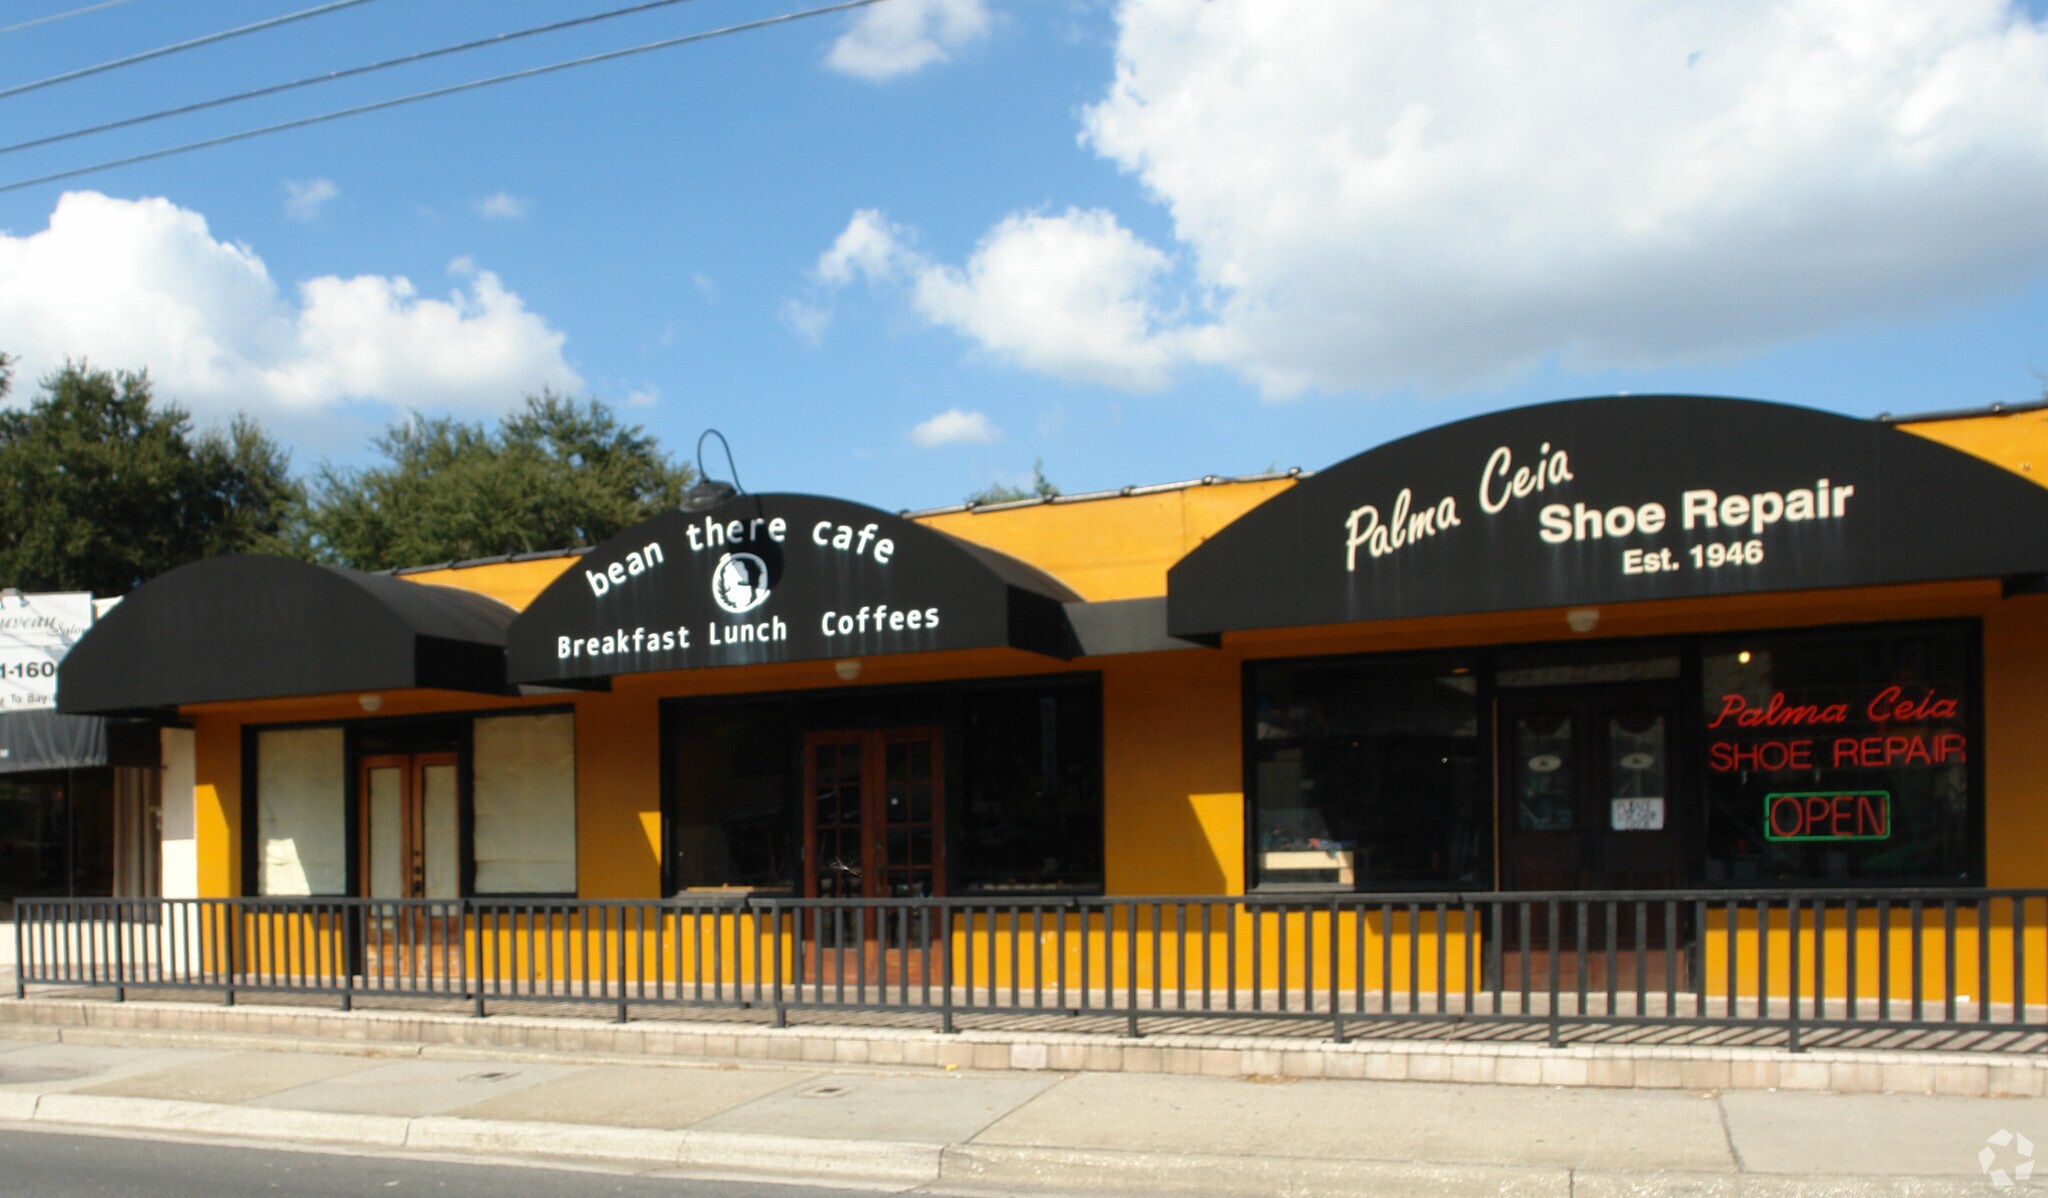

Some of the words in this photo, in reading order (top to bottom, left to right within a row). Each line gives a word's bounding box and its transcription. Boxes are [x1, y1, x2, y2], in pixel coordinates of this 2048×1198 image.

[1345, 489, 1461, 572] Palma
[1478, 442, 1575, 515] Ceia
[1539, 502, 1666, 544] Shoe
[1682, 478, 1854, 535] Repair
[585, 542, 664, 598] bean
[685, 515, 787, 552] there
[812, 520, 895, 564] cafe
[1622, 548, 1680, 575] Est.
[1689, 539, 1764, 569] 1946
[557, 626, 691, 660] Breakfast
[709, 614, 787, 646] Lunch
[821, 604, 940, 637] Coffees
[1708, 691, 1848, 729] Palma
[1867, 685, 1958, 722] Ceia
[1711, 740, 1813, 771] SHOE
[1833, 733, 1966, 768] REPAIR
[1769, 796, 1887, 837] OPEN
